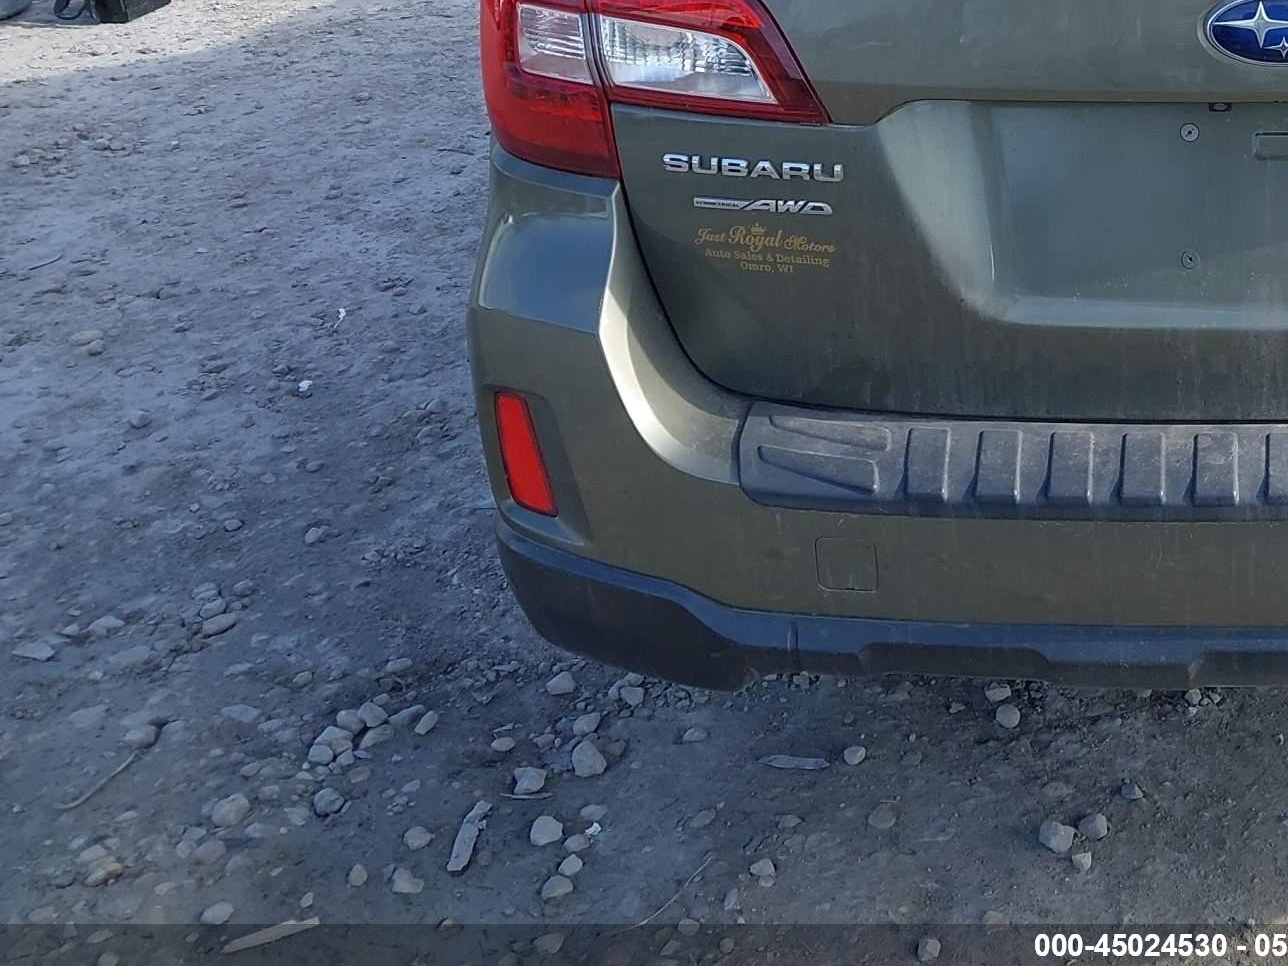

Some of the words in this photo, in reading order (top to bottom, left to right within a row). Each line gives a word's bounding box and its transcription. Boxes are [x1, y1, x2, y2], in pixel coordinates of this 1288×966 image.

[662, 153, 844, 183] SUBARU
[743, 199, 833, 216] AWD
[694, 227, 726, 245] Just
[728, 225, 783, 252] Royal
[783, 234, 838, 253] Motors
[705, 248, 731, 259] Auto
[734, 250, 763, 262] Sales
[766, 252, 774, 262] &
[776, 253, 830, 268] Detailing
[740, 261, 775, 274] Omro,
[778, 264, 793, 273] WI
